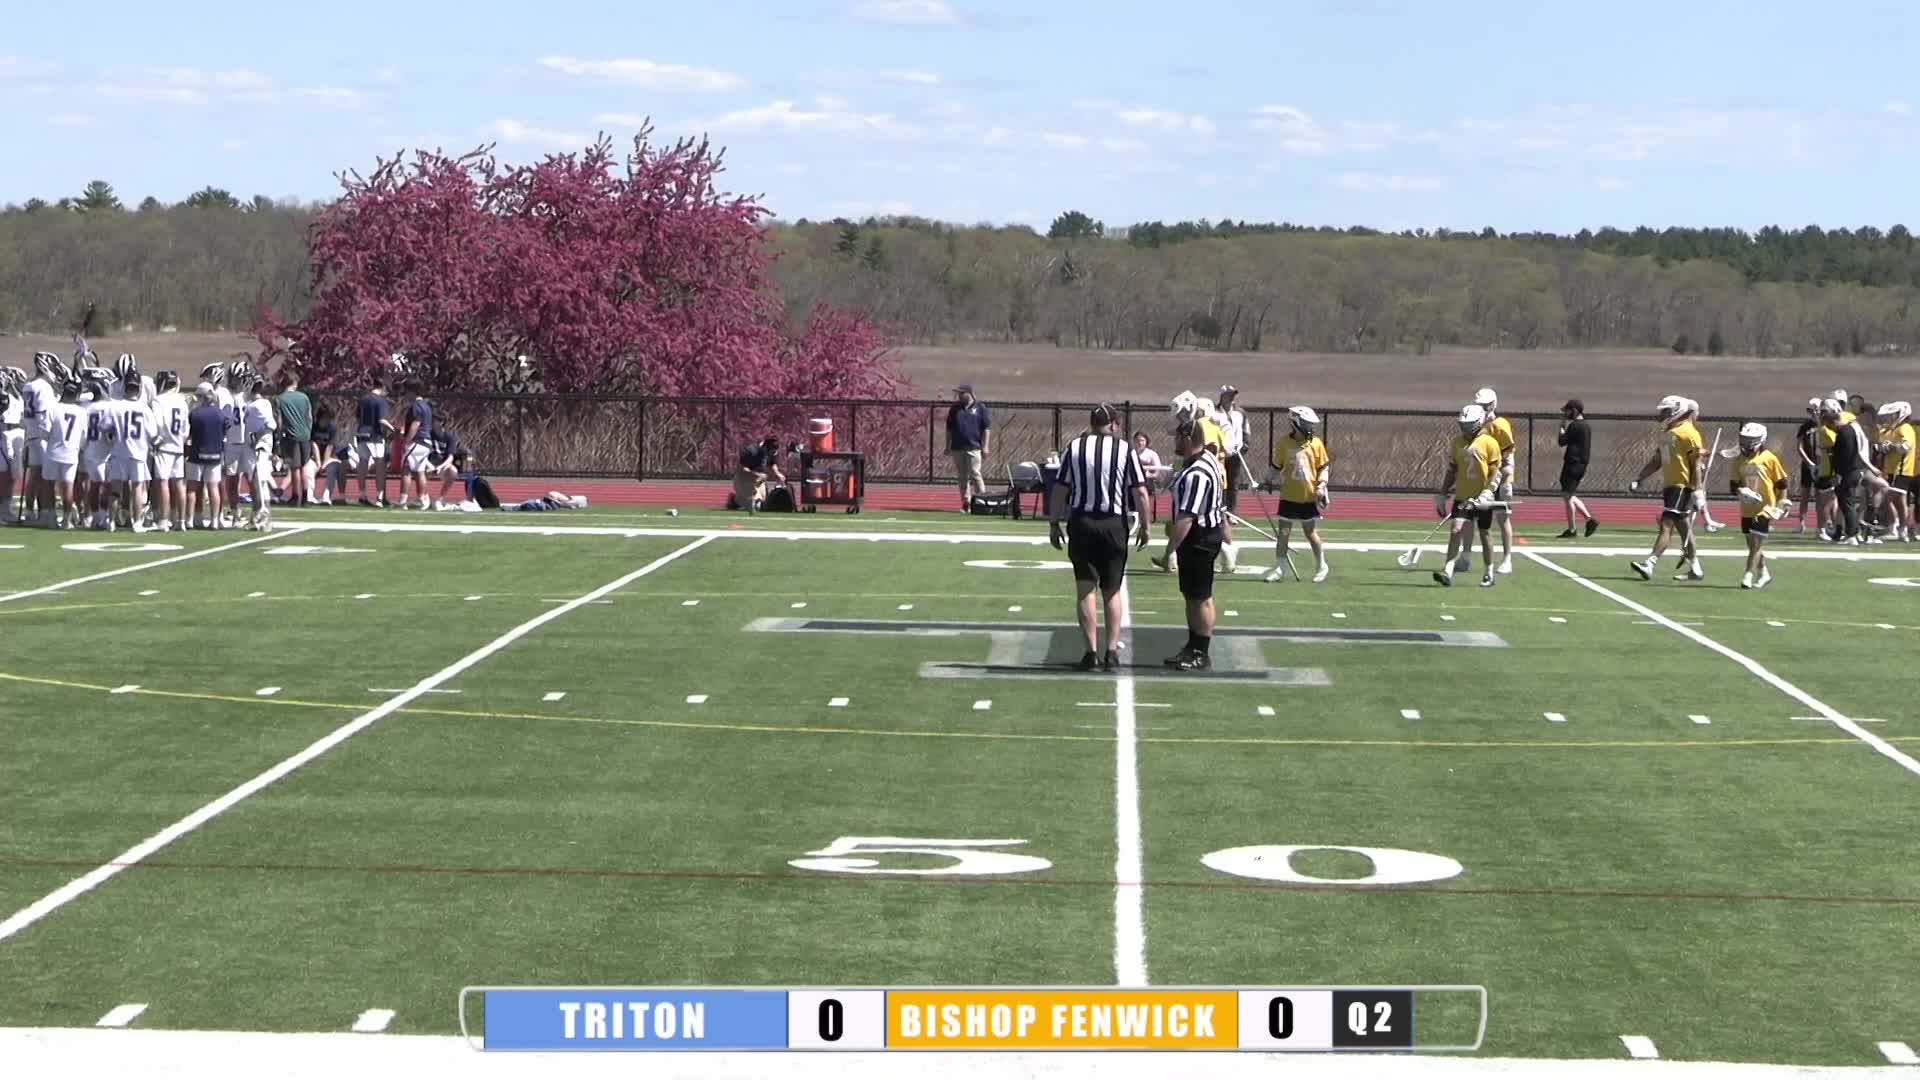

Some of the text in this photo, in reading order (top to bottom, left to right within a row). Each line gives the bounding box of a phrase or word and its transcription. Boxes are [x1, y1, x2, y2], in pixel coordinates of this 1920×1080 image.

[64, 413, 76, 441] 7
[123, 411, 143, 440] 15
[170, 407, 181, 435] 6
